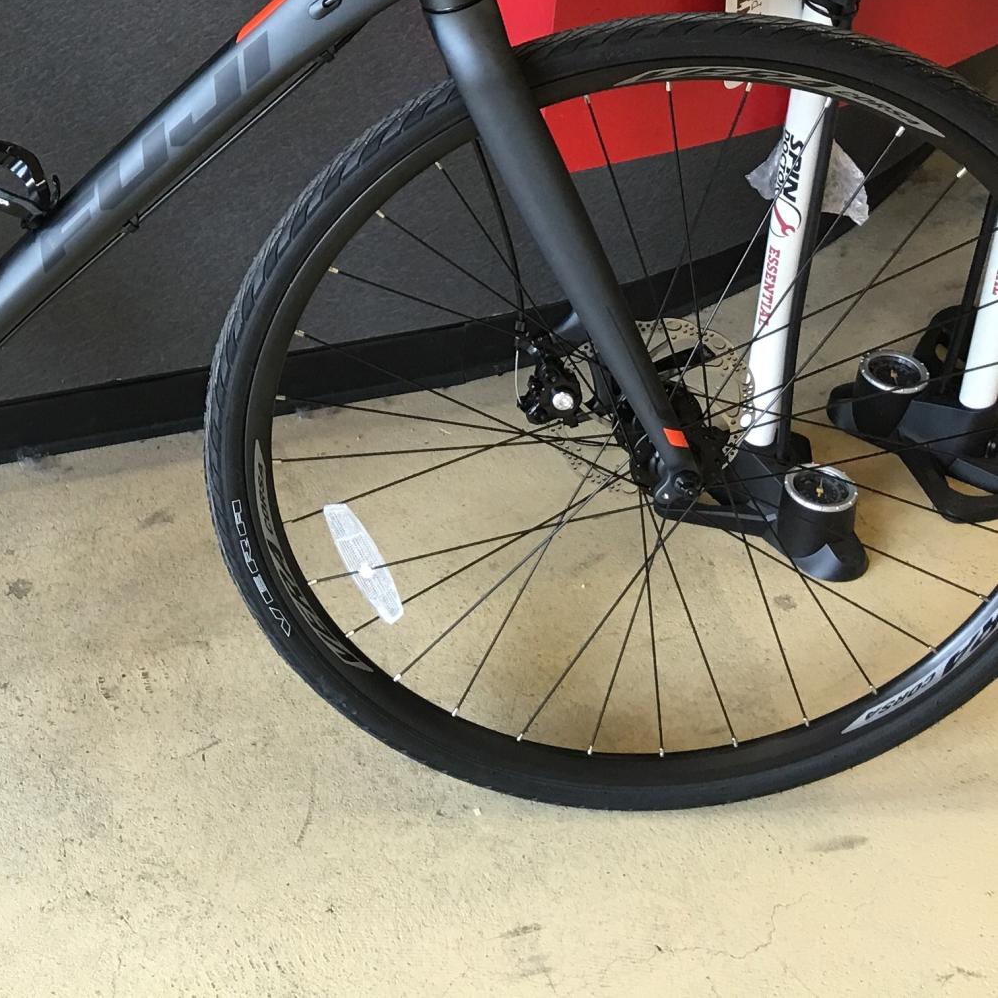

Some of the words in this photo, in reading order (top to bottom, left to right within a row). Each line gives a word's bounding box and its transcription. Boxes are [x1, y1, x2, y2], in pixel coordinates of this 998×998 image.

[40, 29, 271, 274] FUJI
[782, 133, 805, 203] SPIN
[758, 244, 781, 327] ESSENTIAL
[864, 671, 938, 721] CORSA
